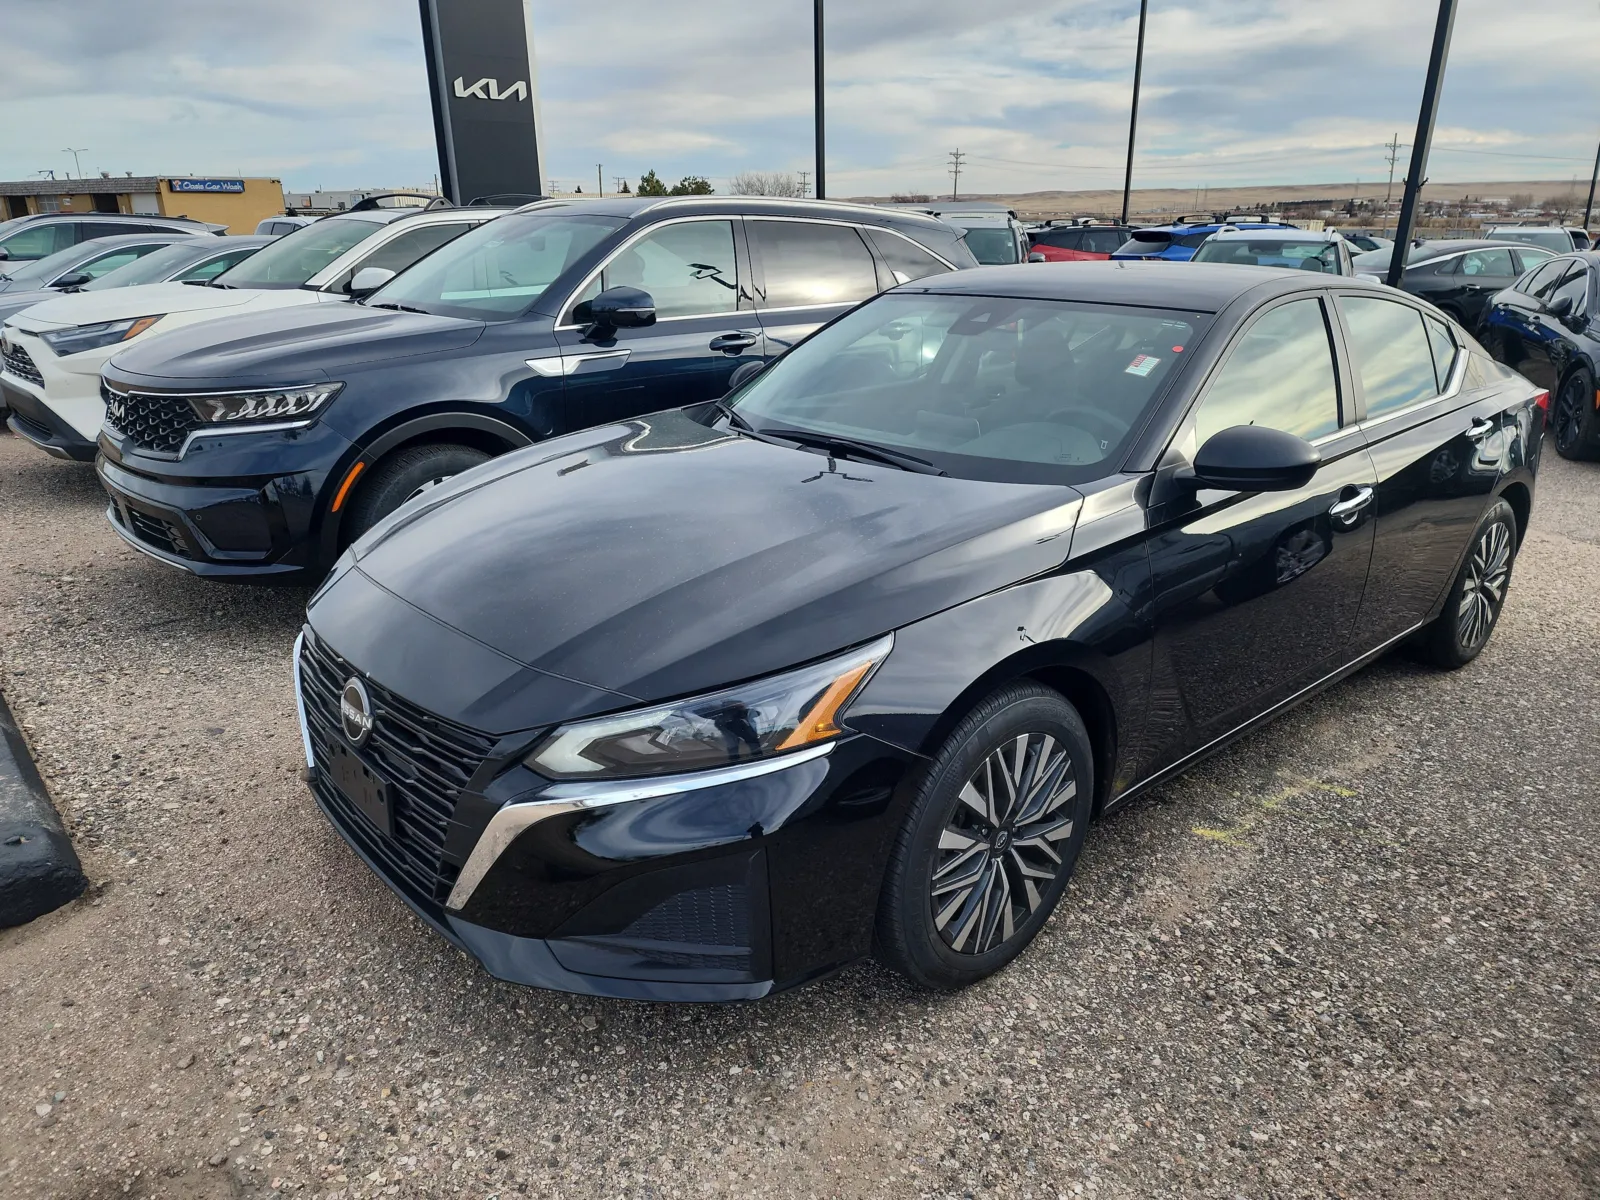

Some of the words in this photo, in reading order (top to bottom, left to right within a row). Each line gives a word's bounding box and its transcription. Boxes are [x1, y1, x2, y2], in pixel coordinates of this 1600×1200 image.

[454, 76, 527, 101] KIA
[183, 182, 204, 190] Oasis
[205, 182, 221, 190] Car
[221, 182, 243, 191] Wash
[341, 702, 371, 729] SSAN
